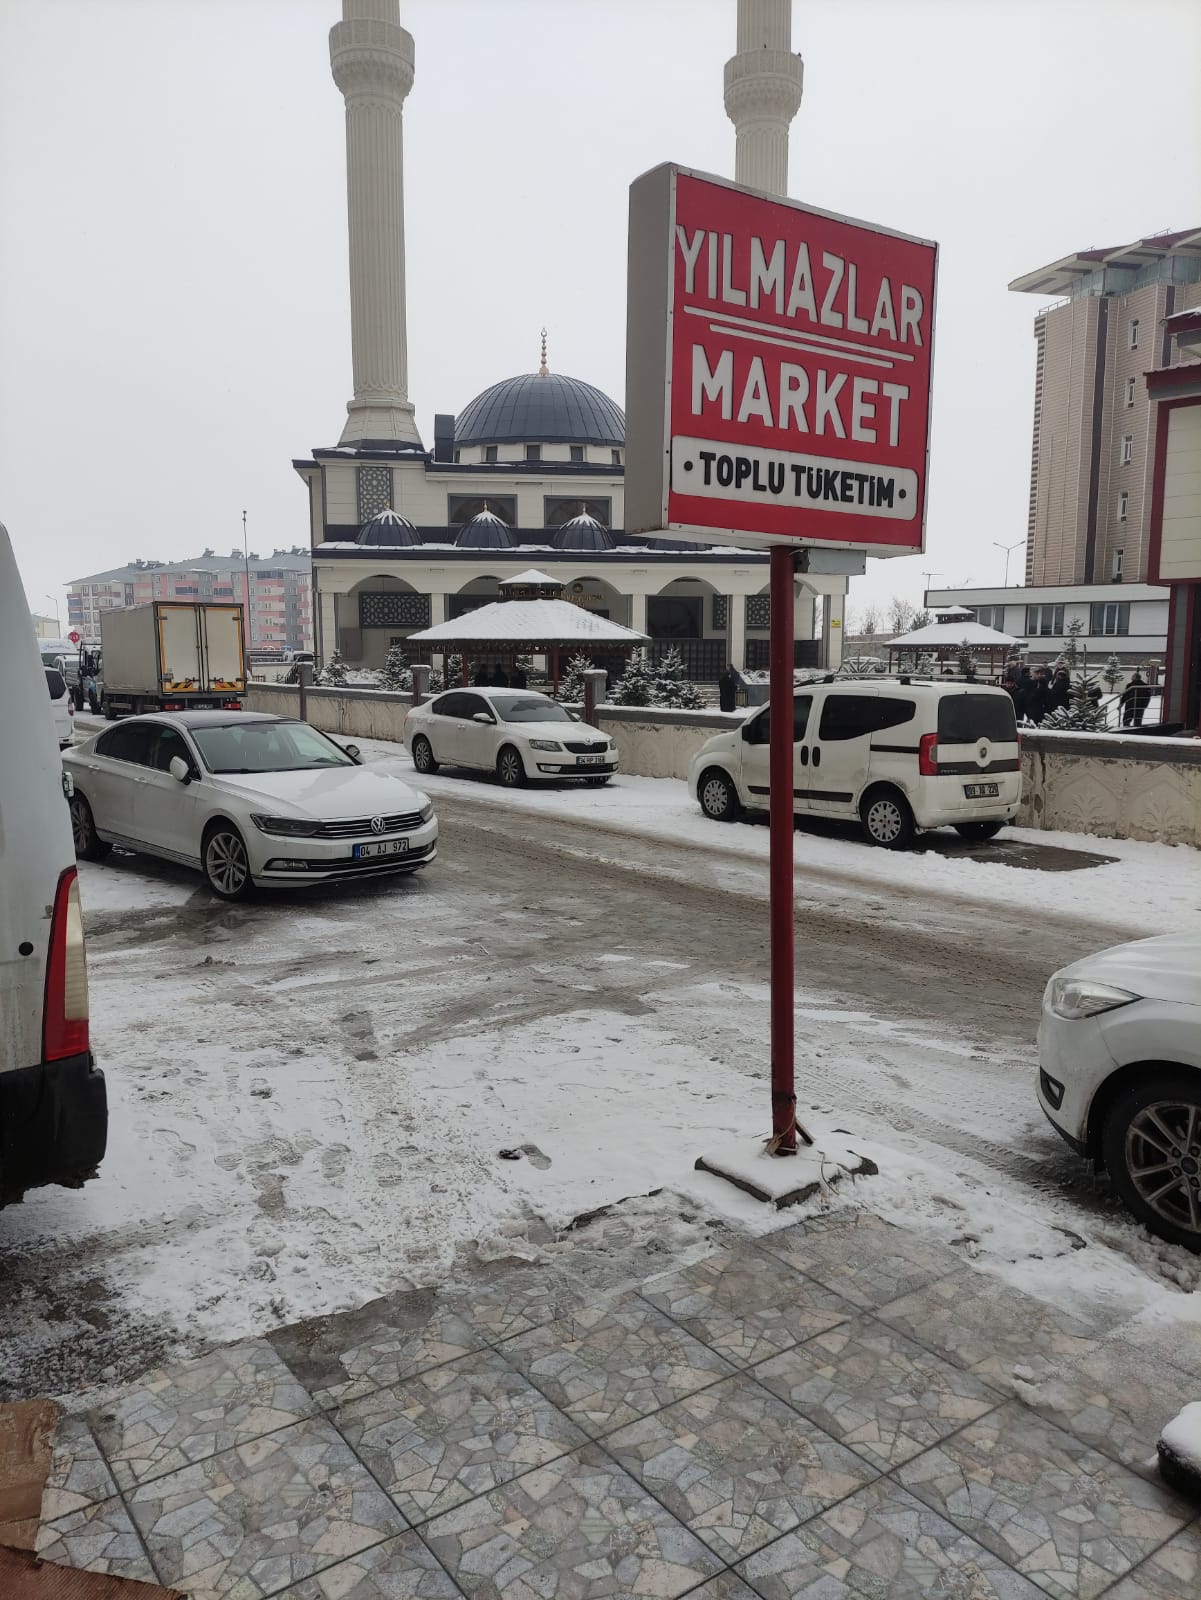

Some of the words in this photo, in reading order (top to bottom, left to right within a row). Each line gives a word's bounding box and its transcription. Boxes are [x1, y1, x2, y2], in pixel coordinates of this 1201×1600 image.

[676, 224, 923, 347] YILMAZLAR
[691, 343, 910, 447] MARKET
[699, 451, 785, 494] TOPLU
[791, 465, 895, 508] TÜKETİM
[361, 846, 370, 857] 04
[377, 843, 387, 854] AJ
[392, 840, 407, 852] 972
